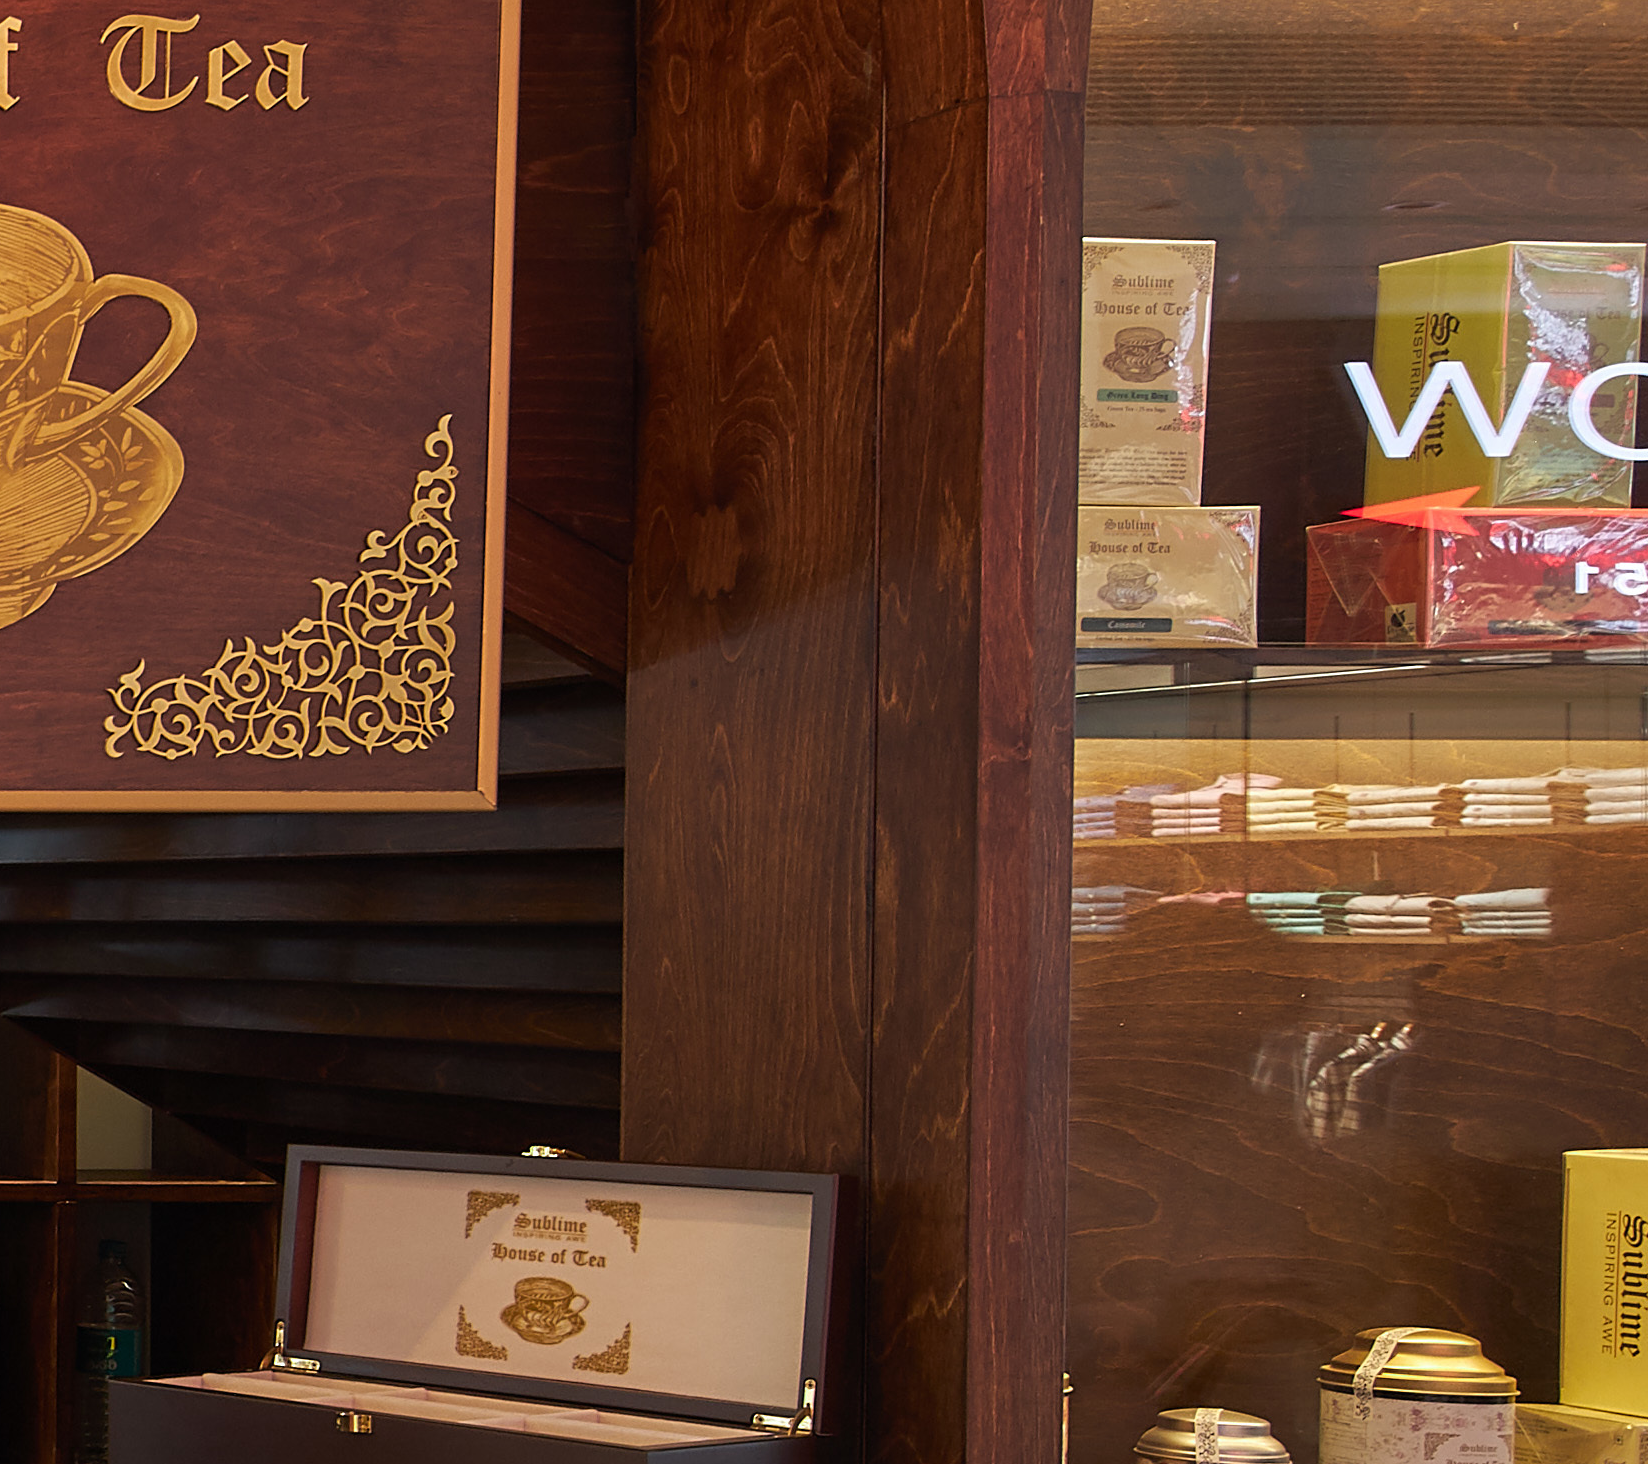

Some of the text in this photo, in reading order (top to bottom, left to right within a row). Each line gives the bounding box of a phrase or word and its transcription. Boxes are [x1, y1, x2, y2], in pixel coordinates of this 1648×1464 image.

[102, 12, 311, 113] Tea
[1112, 274, 1175, 289] Sublime
[1093, 301, 1191, 316] House of Tea
[1104, 518, 1156, 531] Sublime
[1089, 541, 1171, 555] House of Tea
[514, 1213, 588, 1234] Sublime
[491, 1242, 606, 1268] House of Tea
[1601, 1212, 1617, 1355] INSPIRING AWE
